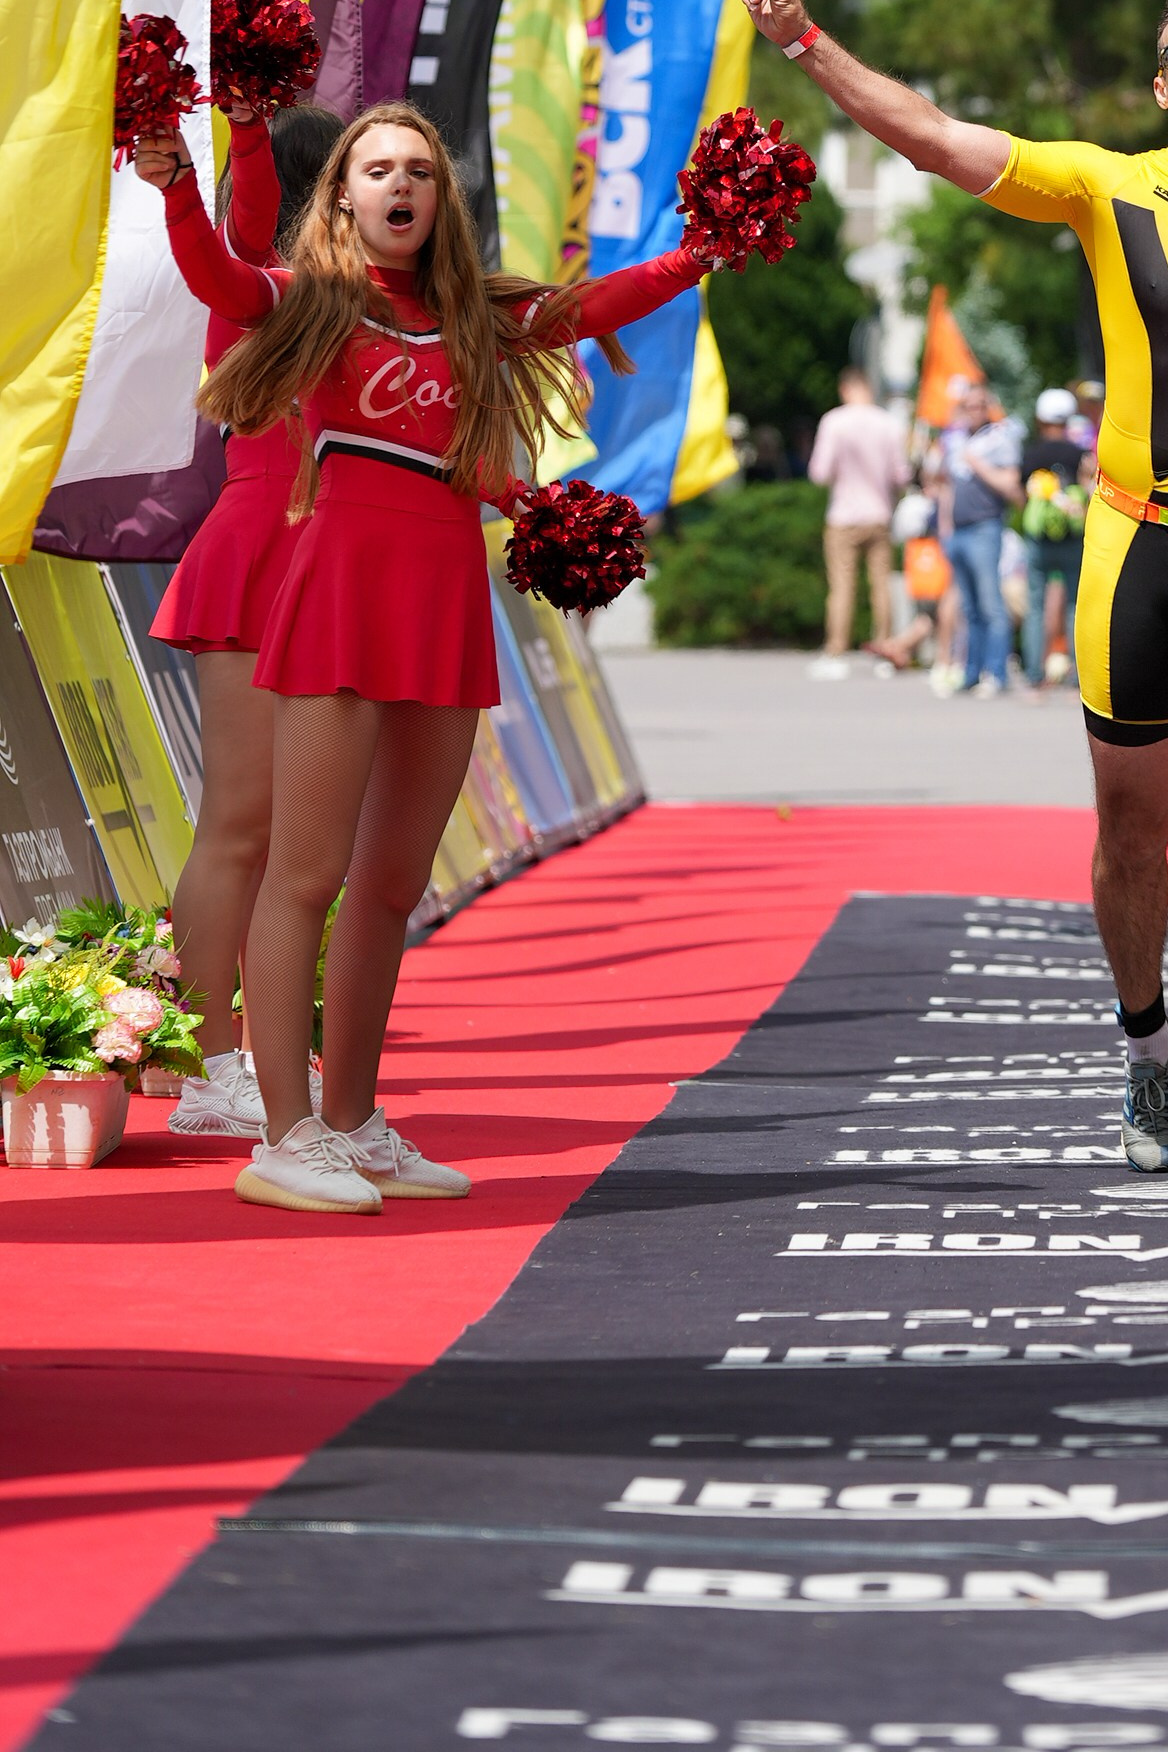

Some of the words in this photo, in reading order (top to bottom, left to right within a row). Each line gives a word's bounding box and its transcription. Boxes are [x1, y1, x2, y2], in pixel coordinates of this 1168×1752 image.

[788, 1233, 1140, 1251] IRON
[722, 1343, 1131, 1365] IRON
[621, 1476, 1118, 1512] IRON
[562, 1560, 1109, 1604] IRON
